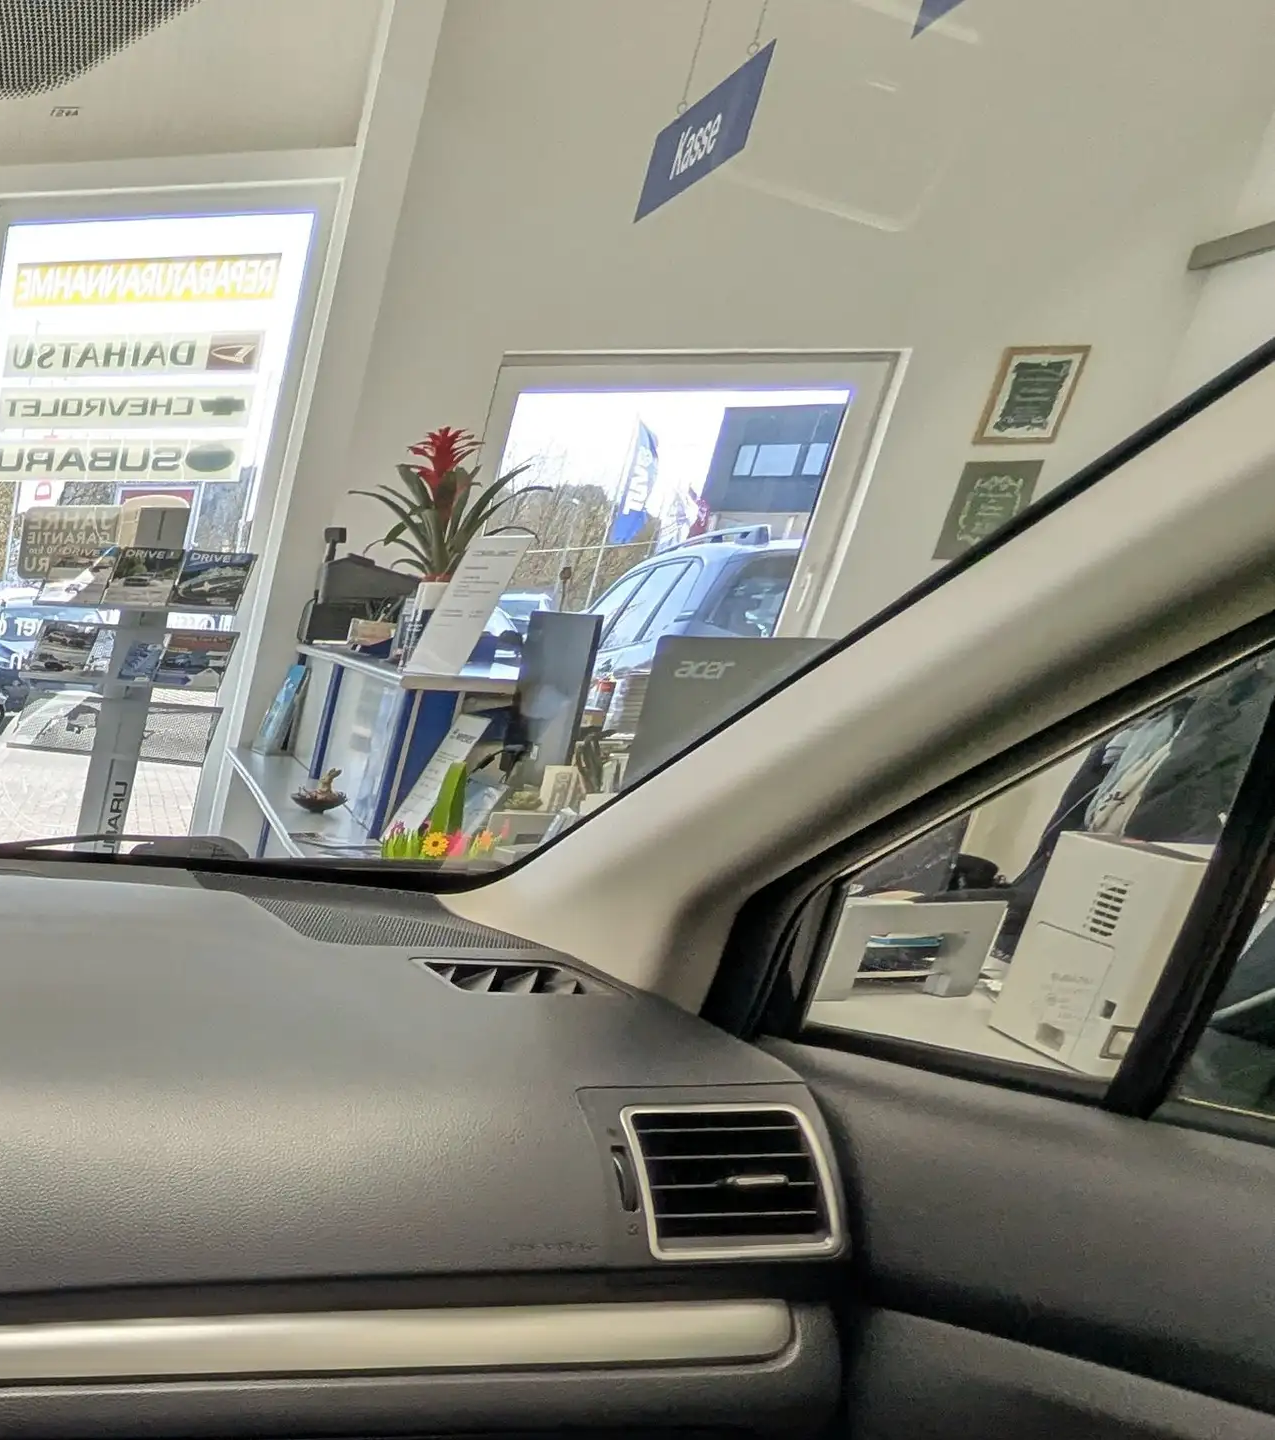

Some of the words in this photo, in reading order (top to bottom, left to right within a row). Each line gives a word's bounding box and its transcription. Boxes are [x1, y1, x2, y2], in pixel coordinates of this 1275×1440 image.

[669, 113, 722, 180] Kasse
[125, 550, 166, 560] DRIVE
[190, 552, 231, 563] DRIVE
[674, 661, 736, 680] acer
